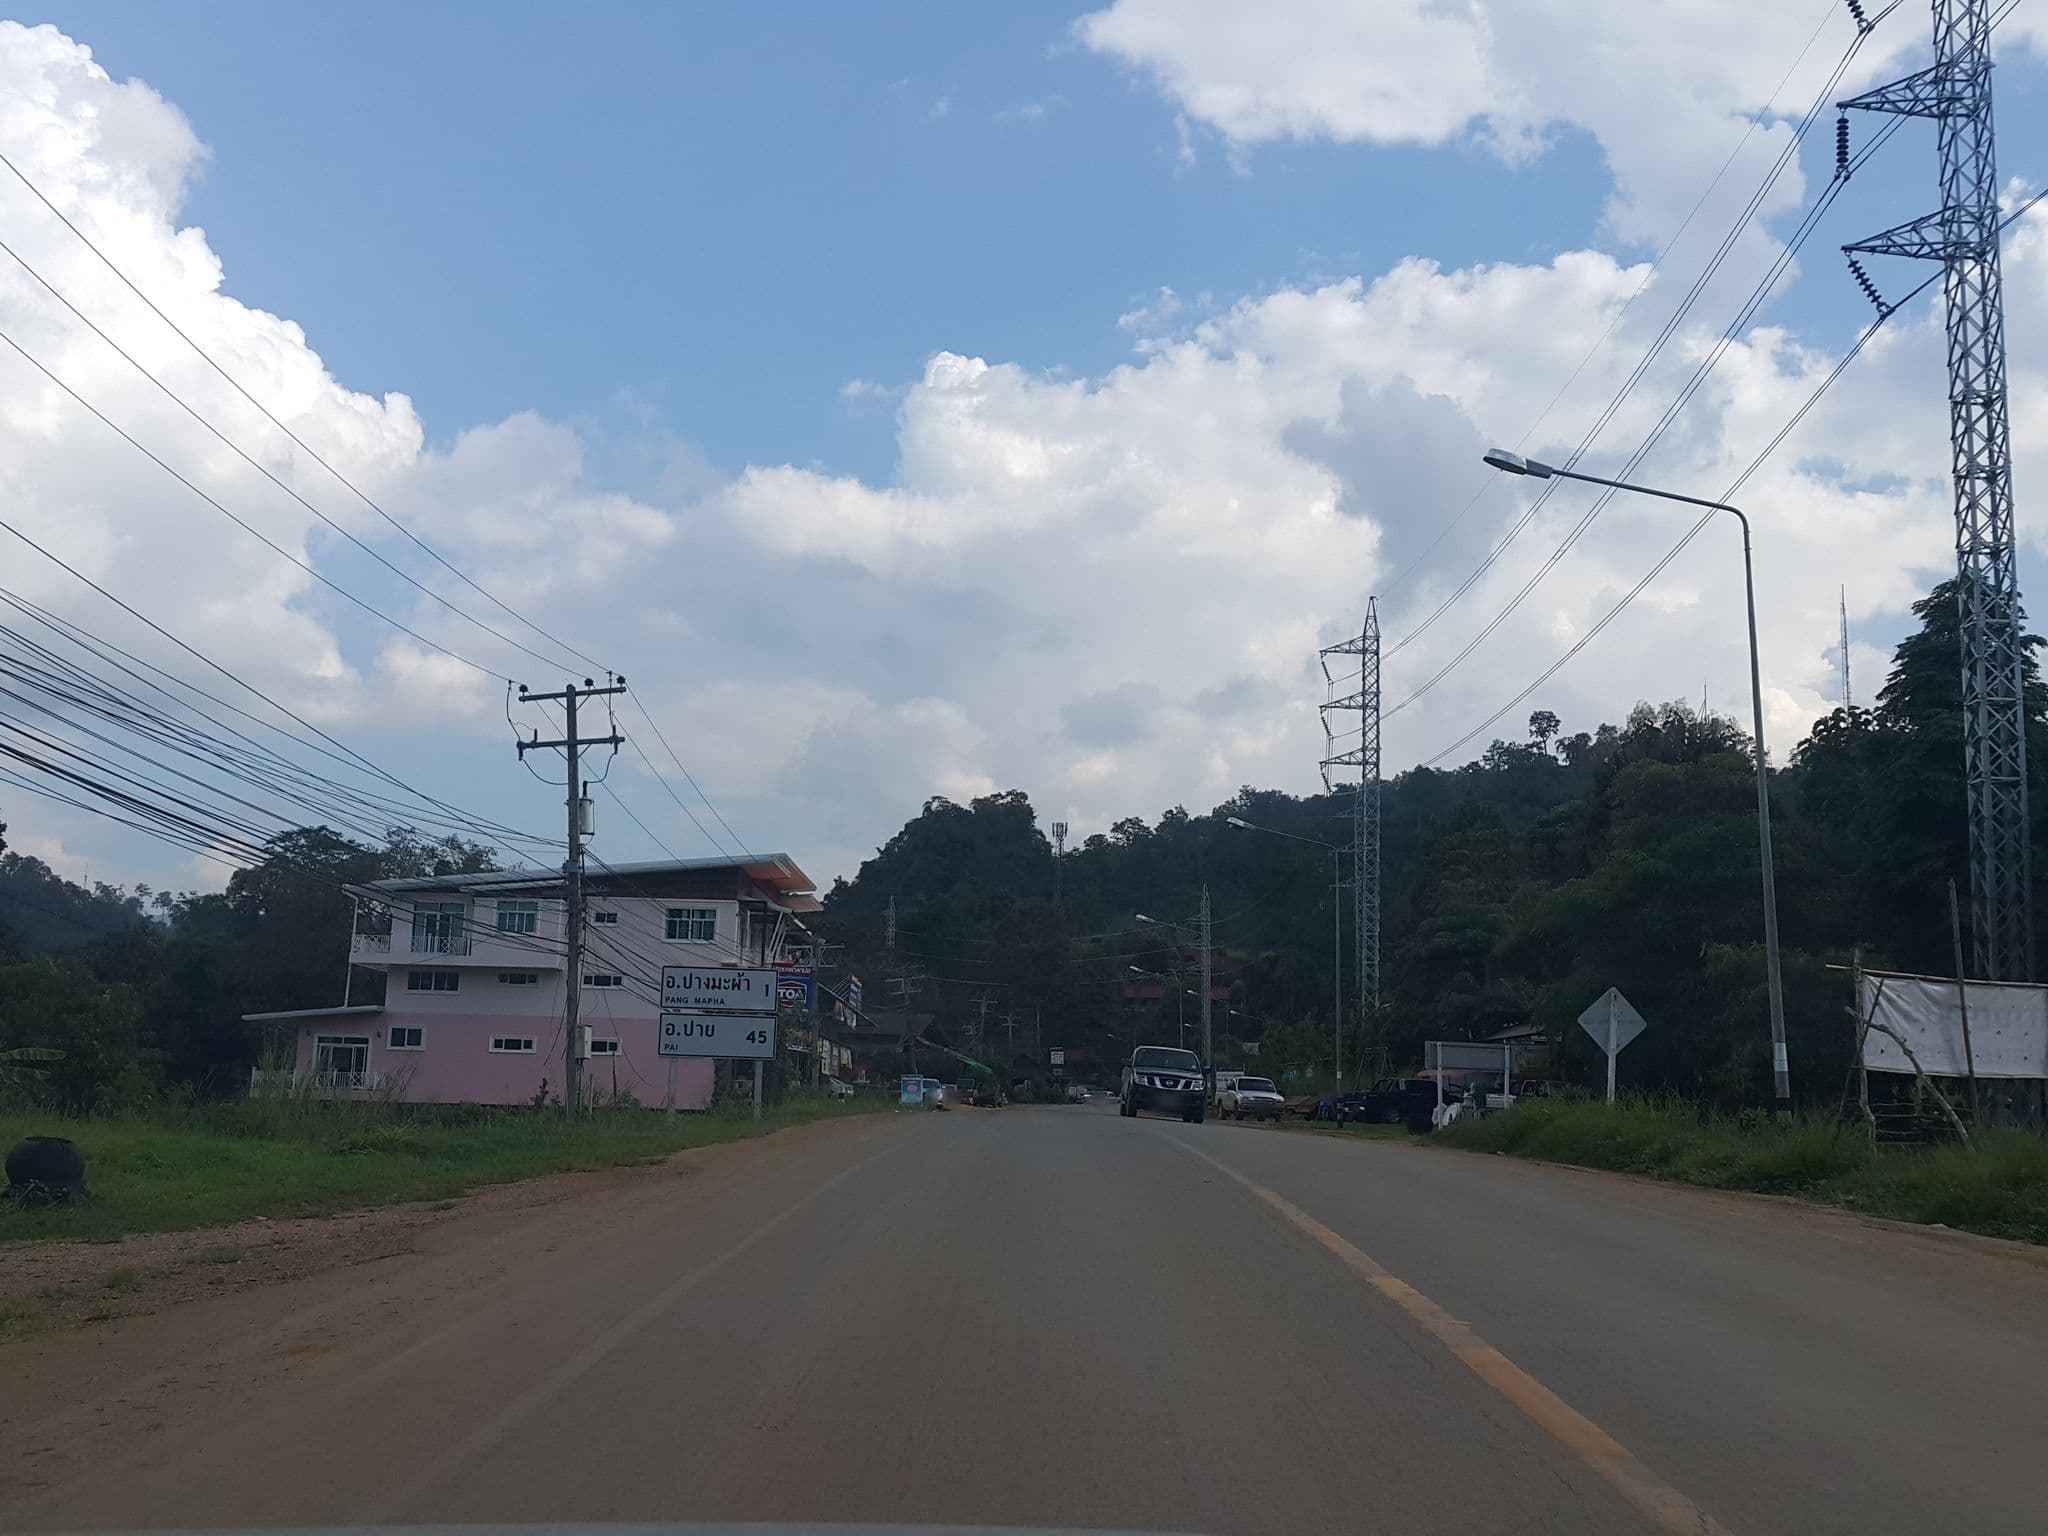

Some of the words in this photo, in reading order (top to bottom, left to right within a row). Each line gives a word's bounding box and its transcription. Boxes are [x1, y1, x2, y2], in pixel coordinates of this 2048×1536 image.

[666, 972, 751, 992] อ.ปางมะผ้า
[764, 984, 770, 997] 1
[777, 989, 804, 1000] TOA
[665, 996, 689, 1004] PANG
[694, 997, 725, 1005] MAPHA
[665, 1020, 716, 1038] อ.ปาย
[746, 1030, 767, 1044] 45
[664, 1043, 678, 1051] PAI
